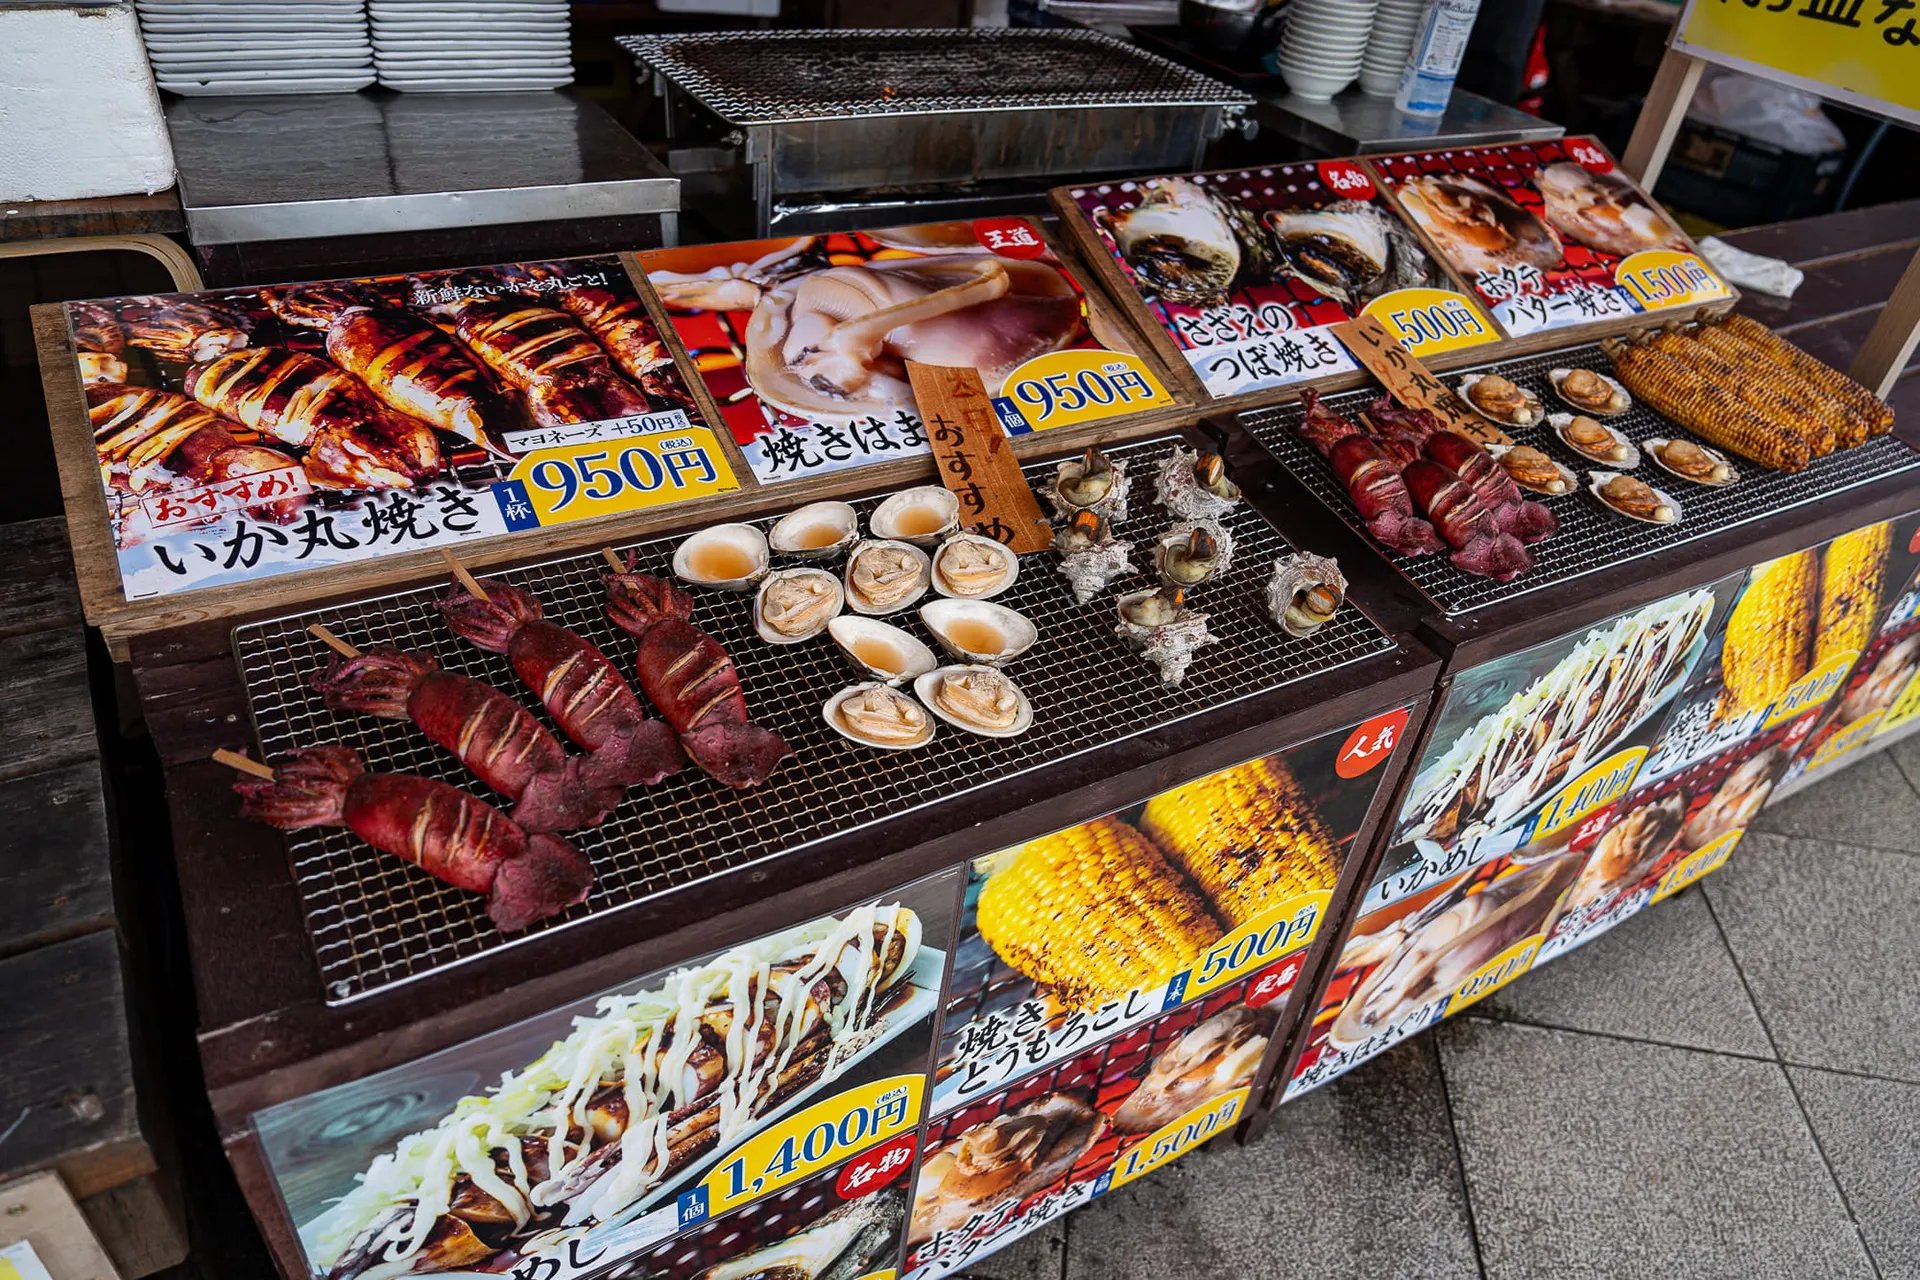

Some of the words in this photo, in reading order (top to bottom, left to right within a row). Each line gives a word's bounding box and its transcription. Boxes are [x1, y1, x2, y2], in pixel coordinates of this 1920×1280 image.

[984, 227, 1039, 249] 王道
[1479, 263, 1542, 296] ホタテ
[1178, 304, 1293, 346] さざえの
[1391, 305, 1483, 352] ,500円
[1508, 285, 1622, 325] バター焼き
[1209, 333, 1338, 381] つぼ焼き
[1016, 370, 1155, 421] 950円
[510, 423, 603, 447] マヨネーズ
[156, 471, 298, 521] おすすめ!
[502, 488, 532, 522] 1杯
[532, 447, 718, 513] 950円
[930, 414, 1016, 546] おすすめ
[153, 486, 480, 575] いか丸焼き
[1343, 724, 1396, 761] 人気
[1380, 836, 1488, 900] いかめし
[1197, 910, 1318, 984] 500円
[1250, 963, 1298, 1000] 定番
[955, 1001, 1045, 1064] 焼き
[957, 989, 1150, 1095] とうもろこし
[722, 1095, 909, 1200] 1,400円
[843, 1147, 911, 1192] 名物
[914, 1181, 1088, 1280] バター焼き
[919, 1200, 1018, 1260] ホタテ
